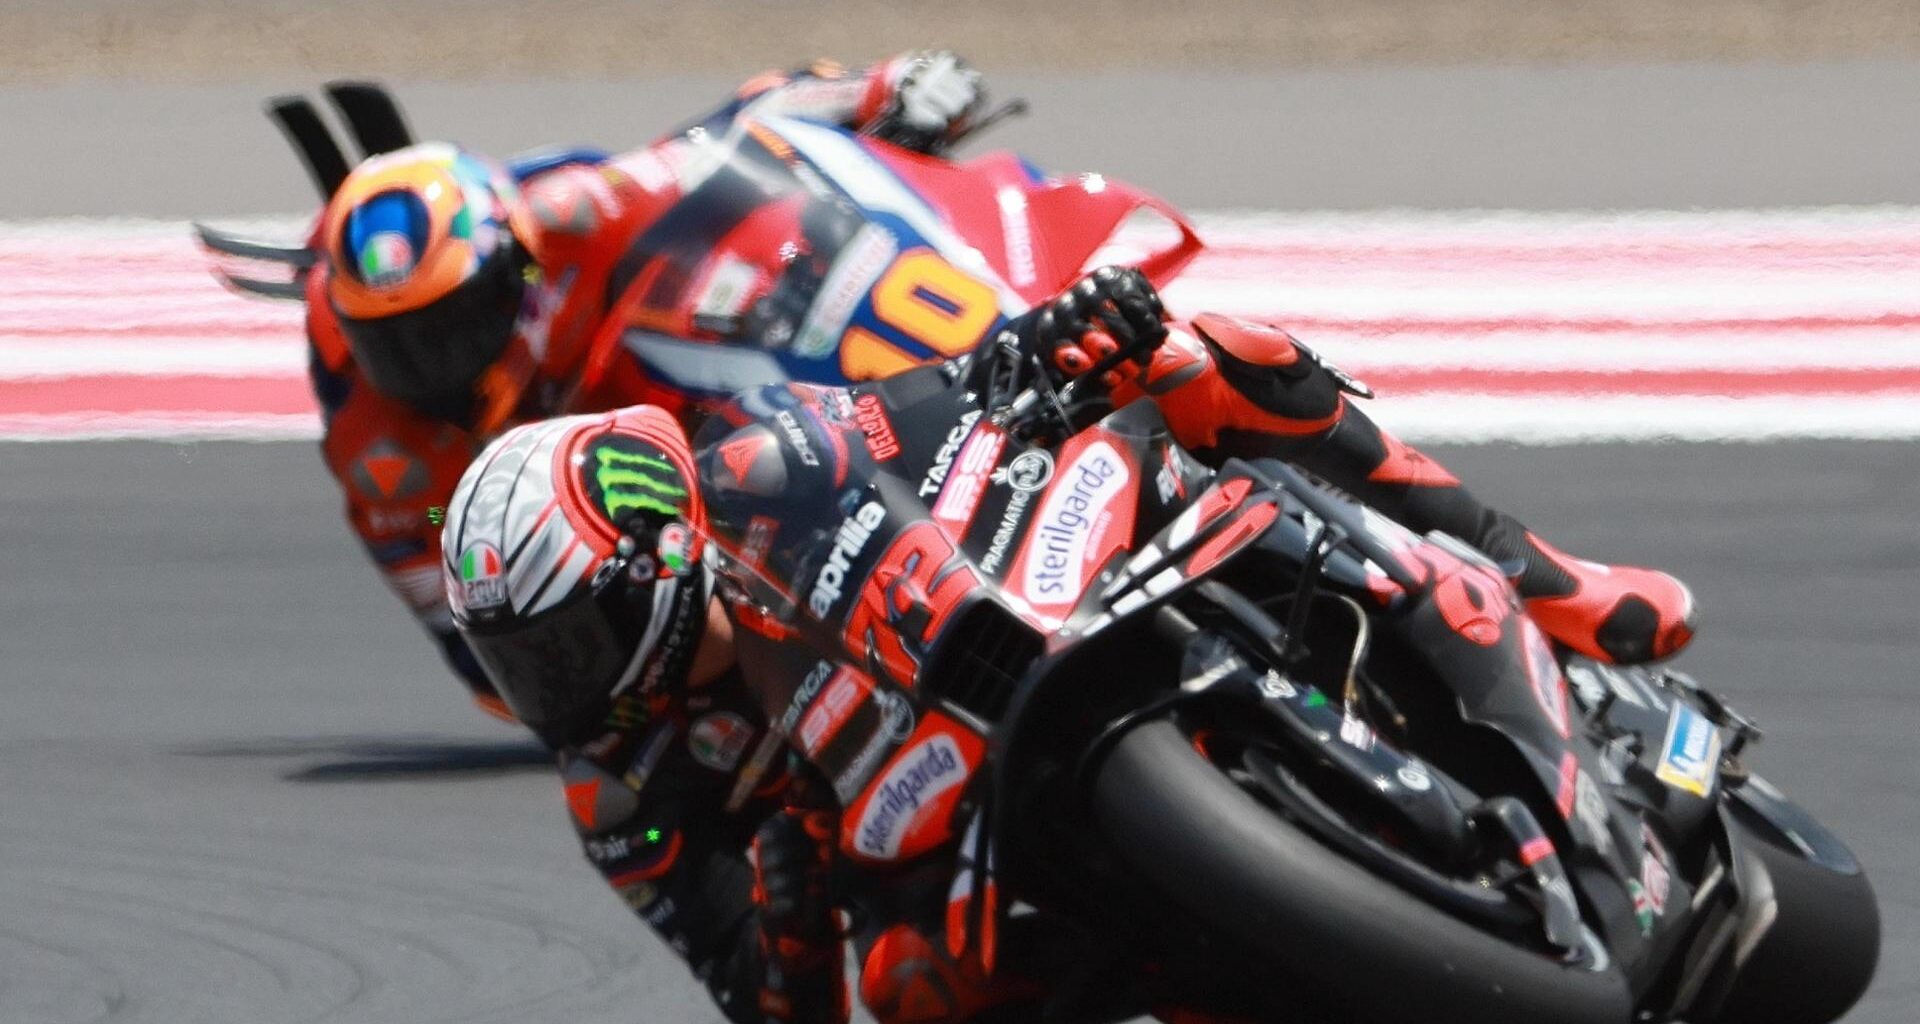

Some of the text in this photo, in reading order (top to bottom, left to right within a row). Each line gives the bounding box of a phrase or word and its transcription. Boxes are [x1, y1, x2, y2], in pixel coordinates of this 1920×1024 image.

[809, 501, 887, 620] aprilia
[980, 489, 1031, 575] PRAGMATIC
[1034, 457, 1115, 594] sterilgarda
[863, 742, 957, 854] sterilgarda
